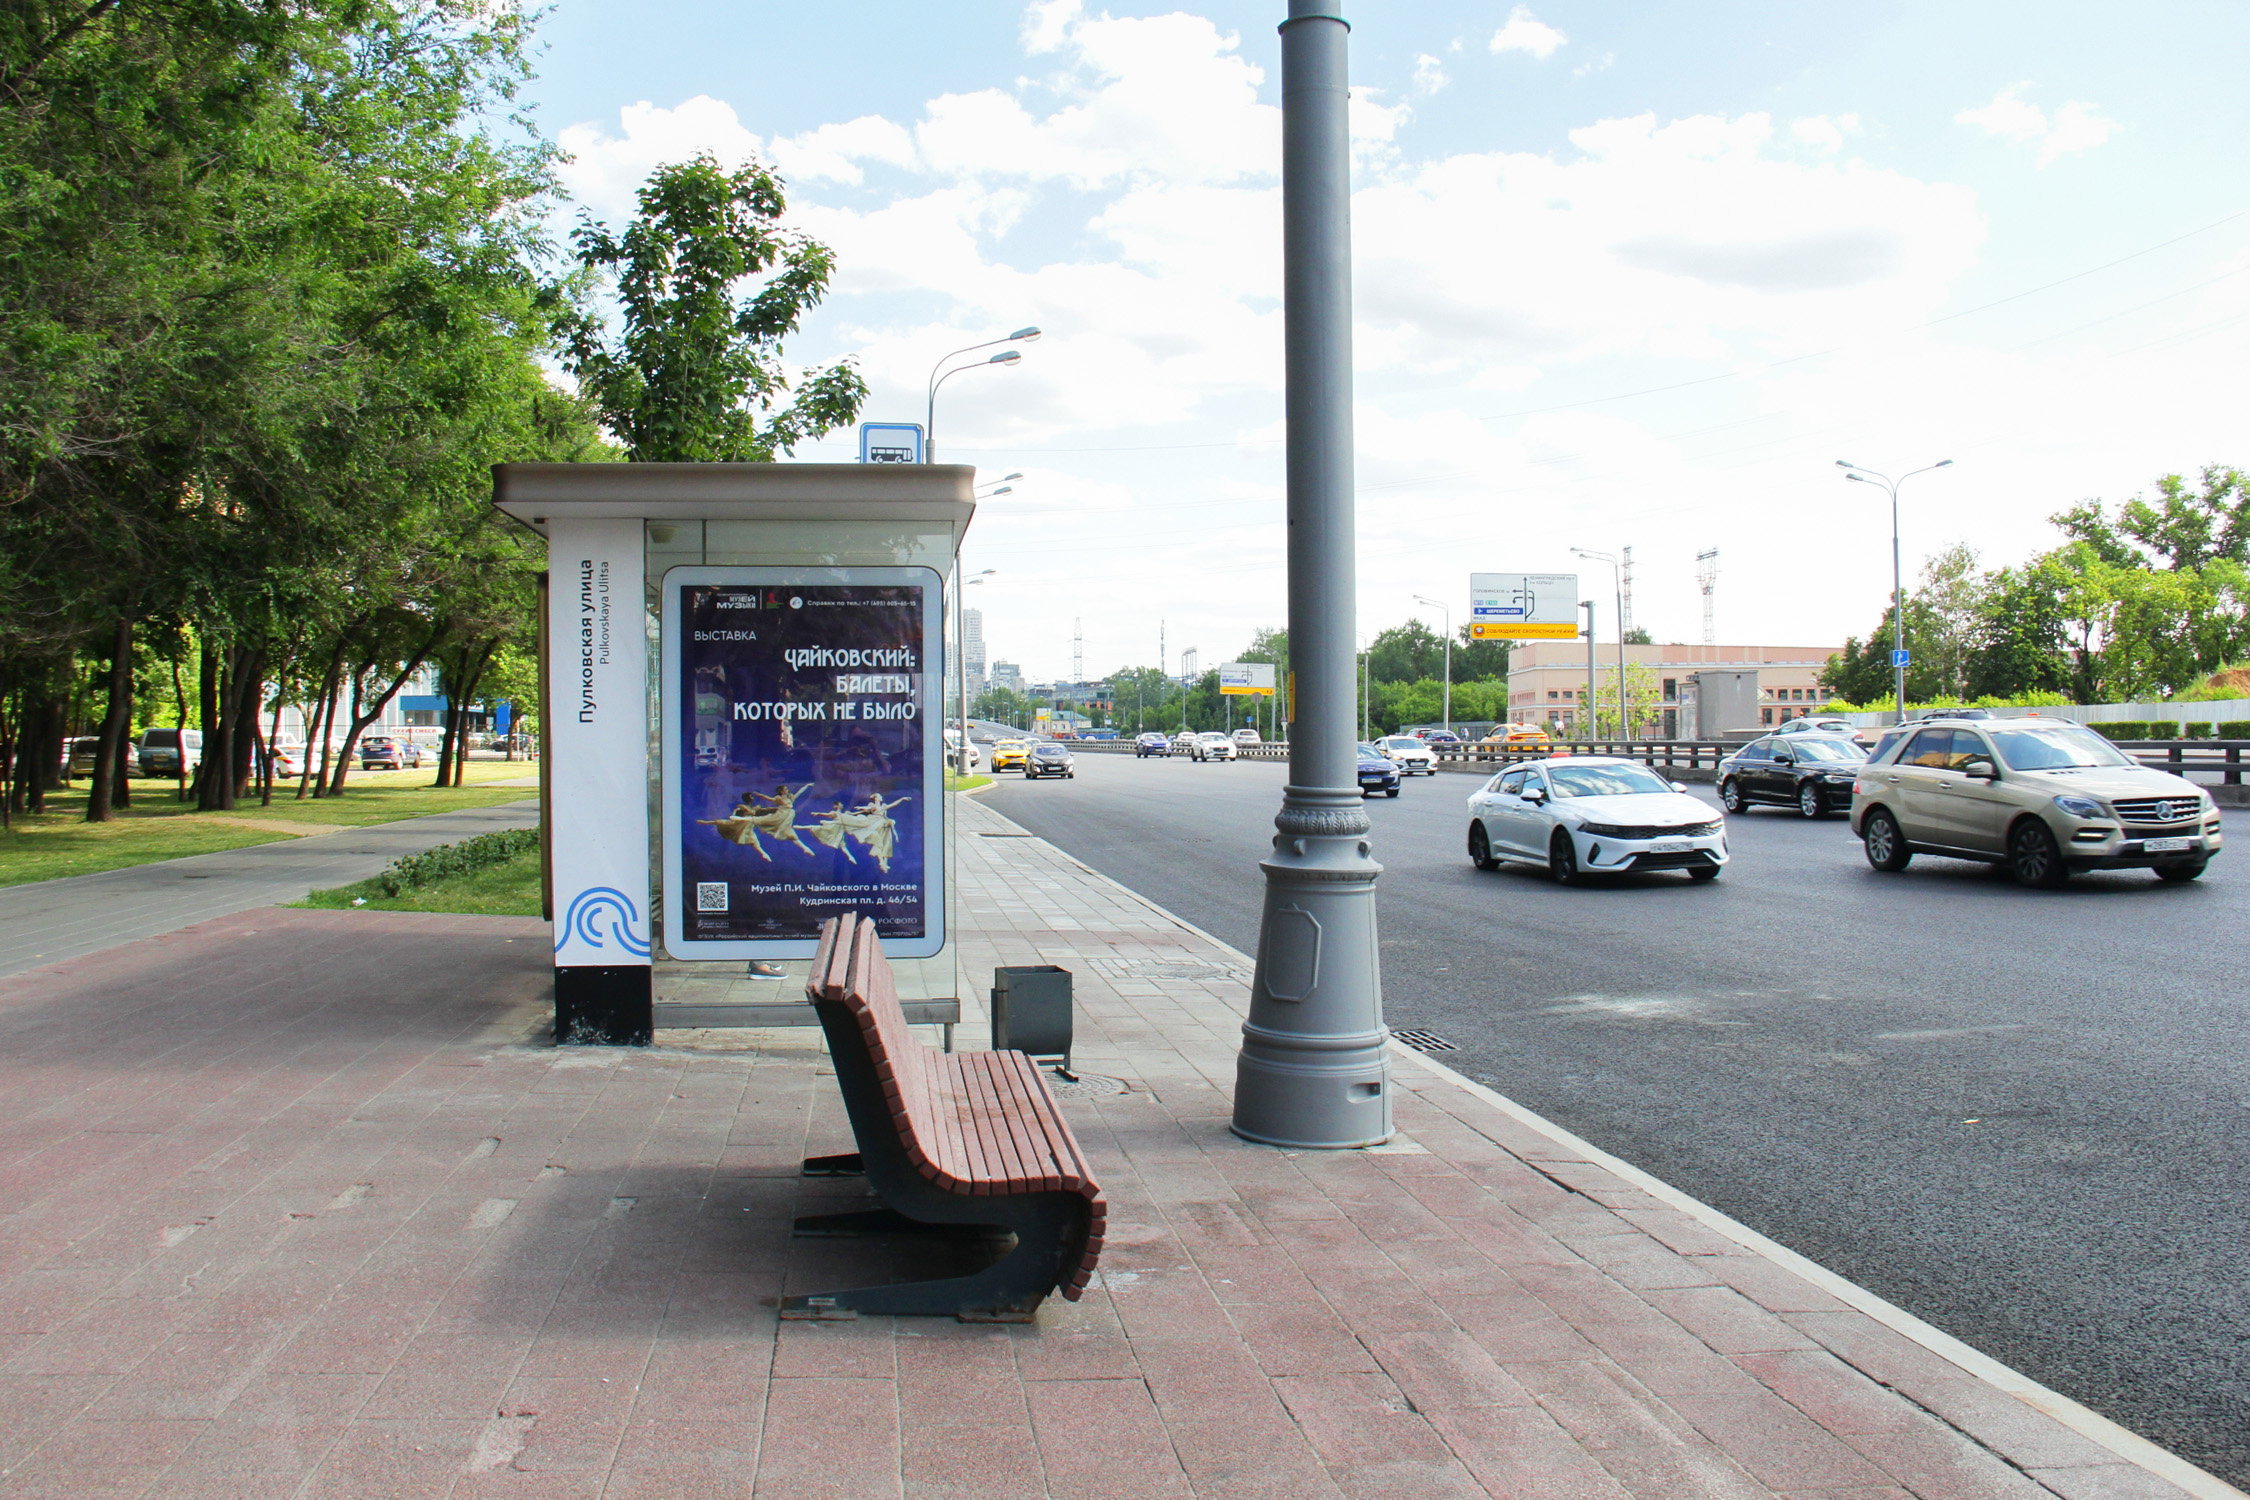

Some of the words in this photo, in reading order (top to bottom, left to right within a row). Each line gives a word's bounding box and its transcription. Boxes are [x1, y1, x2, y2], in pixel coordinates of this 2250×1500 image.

[580, 559, 596, 612] улица
[598, 561, 610, 593] Ulitsa
[598, 596, 612, 665] Pulkovskaya
[694, 630, 757, 641] ВЫСТАВКА
[579, 617, 597, 723] Пулковская
[785, 645, 916, 672] ЧАЙКОВСКИЙ:
[836, 675, 916, 698] БАЛЕТЫ,
[733, 701, 826, 720] КОТОРЫХ
[833, 702, 856, 720] НЕ
[862, 701, 916, 720] БЫЛО
[751, 883, 782, 893] Музей
[784, 883, 805, 892] П.И.
[807, 882, 870, 892] Чайковского
[880, 882, 918, 891] Москве
[800, 895, 858, 906] Кудринская
[860, 896, 874, 905] пл.
[876, 896, 886, 906] д.
[888, 895, 918, 905] 46/54
[878, 917, 918, 925] РОСФОТО
